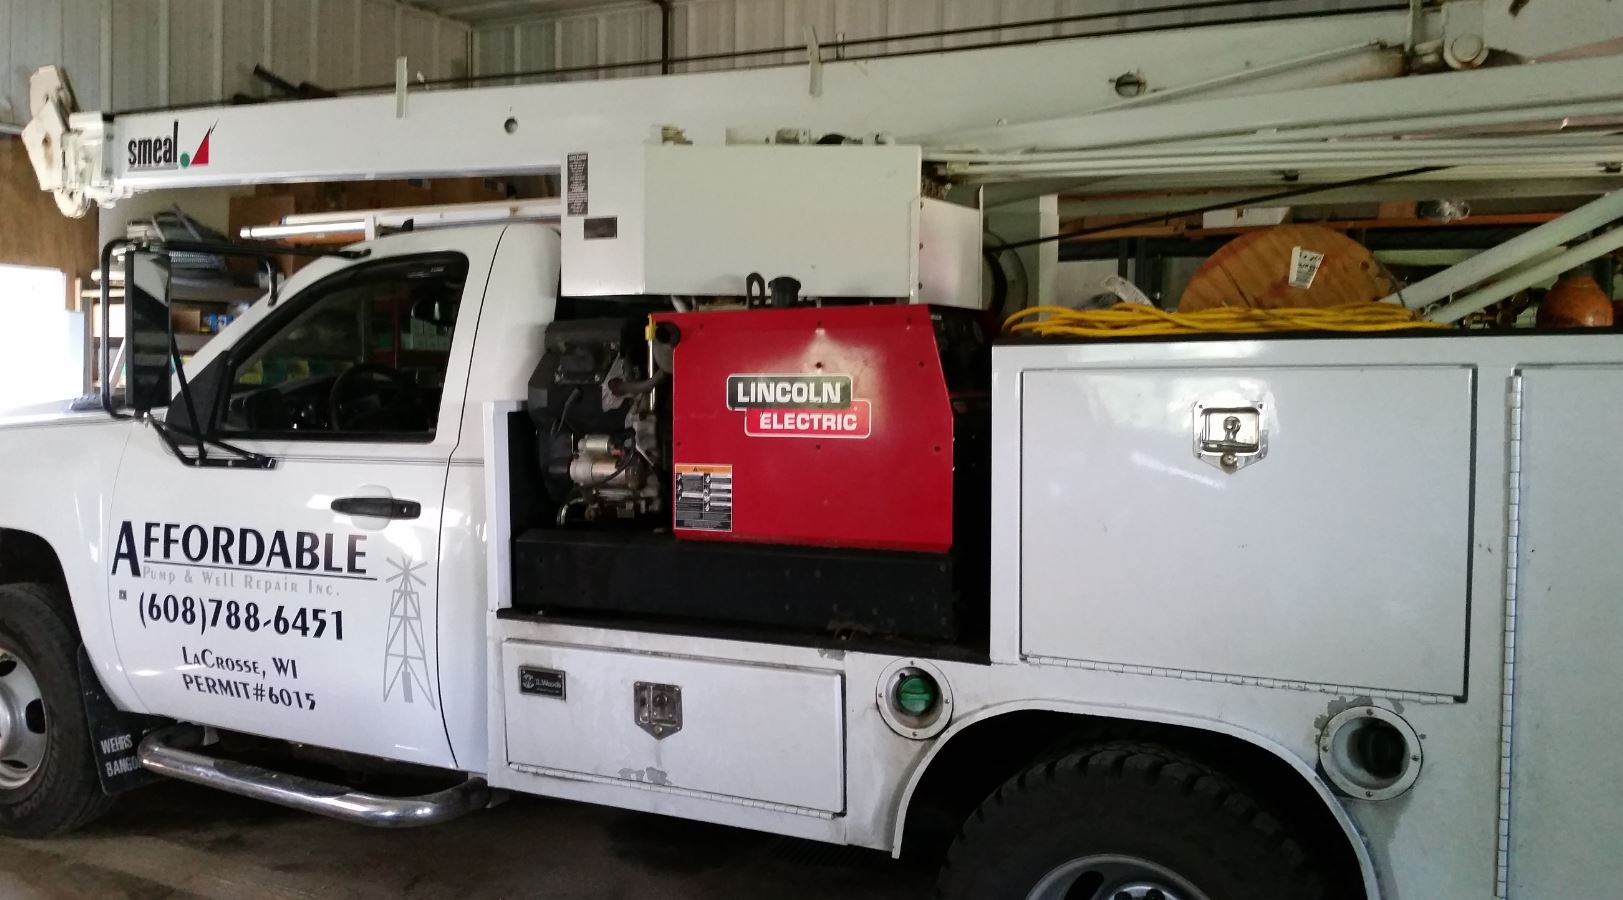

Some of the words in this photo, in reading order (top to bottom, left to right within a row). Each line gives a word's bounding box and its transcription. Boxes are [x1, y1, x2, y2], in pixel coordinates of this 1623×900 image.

[127, 120, 179, 165] smeal
[737, 381, 841, 404] LINCOLN
[759, 412, 858, 431] ELECTRIC
[111, 520, 368, 578] AFFORDABLE
[184, 568, 193, 584] &
[139, 591, 343, 641] (608)788-6451
[272, 656, 298, 680] WI
[181, 673, 317, 711] PERMIT#6015
[100, 733, 133, 755] WEHRS
